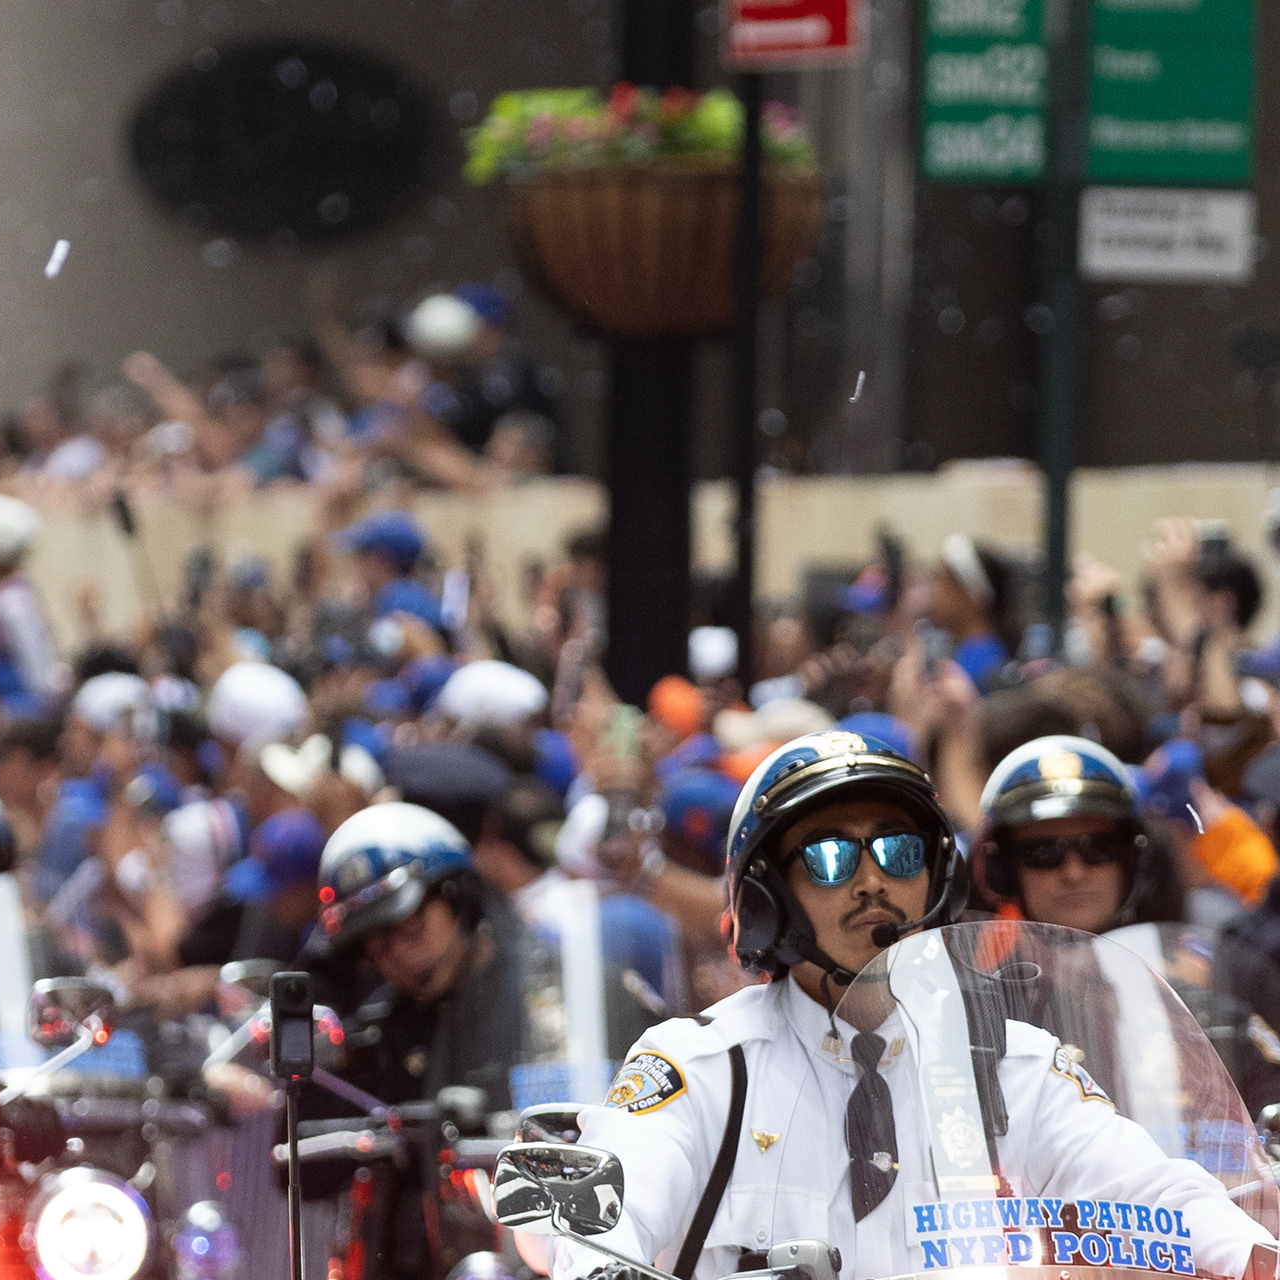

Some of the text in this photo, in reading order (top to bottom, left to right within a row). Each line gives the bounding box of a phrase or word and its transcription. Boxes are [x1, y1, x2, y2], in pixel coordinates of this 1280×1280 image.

[629, 1094, 663, 1111] YORK
[912, 1198, 1191, 1239] HIGHWAY PATROL
[920, 1231, 1196, 1275] NYPD POLICE
